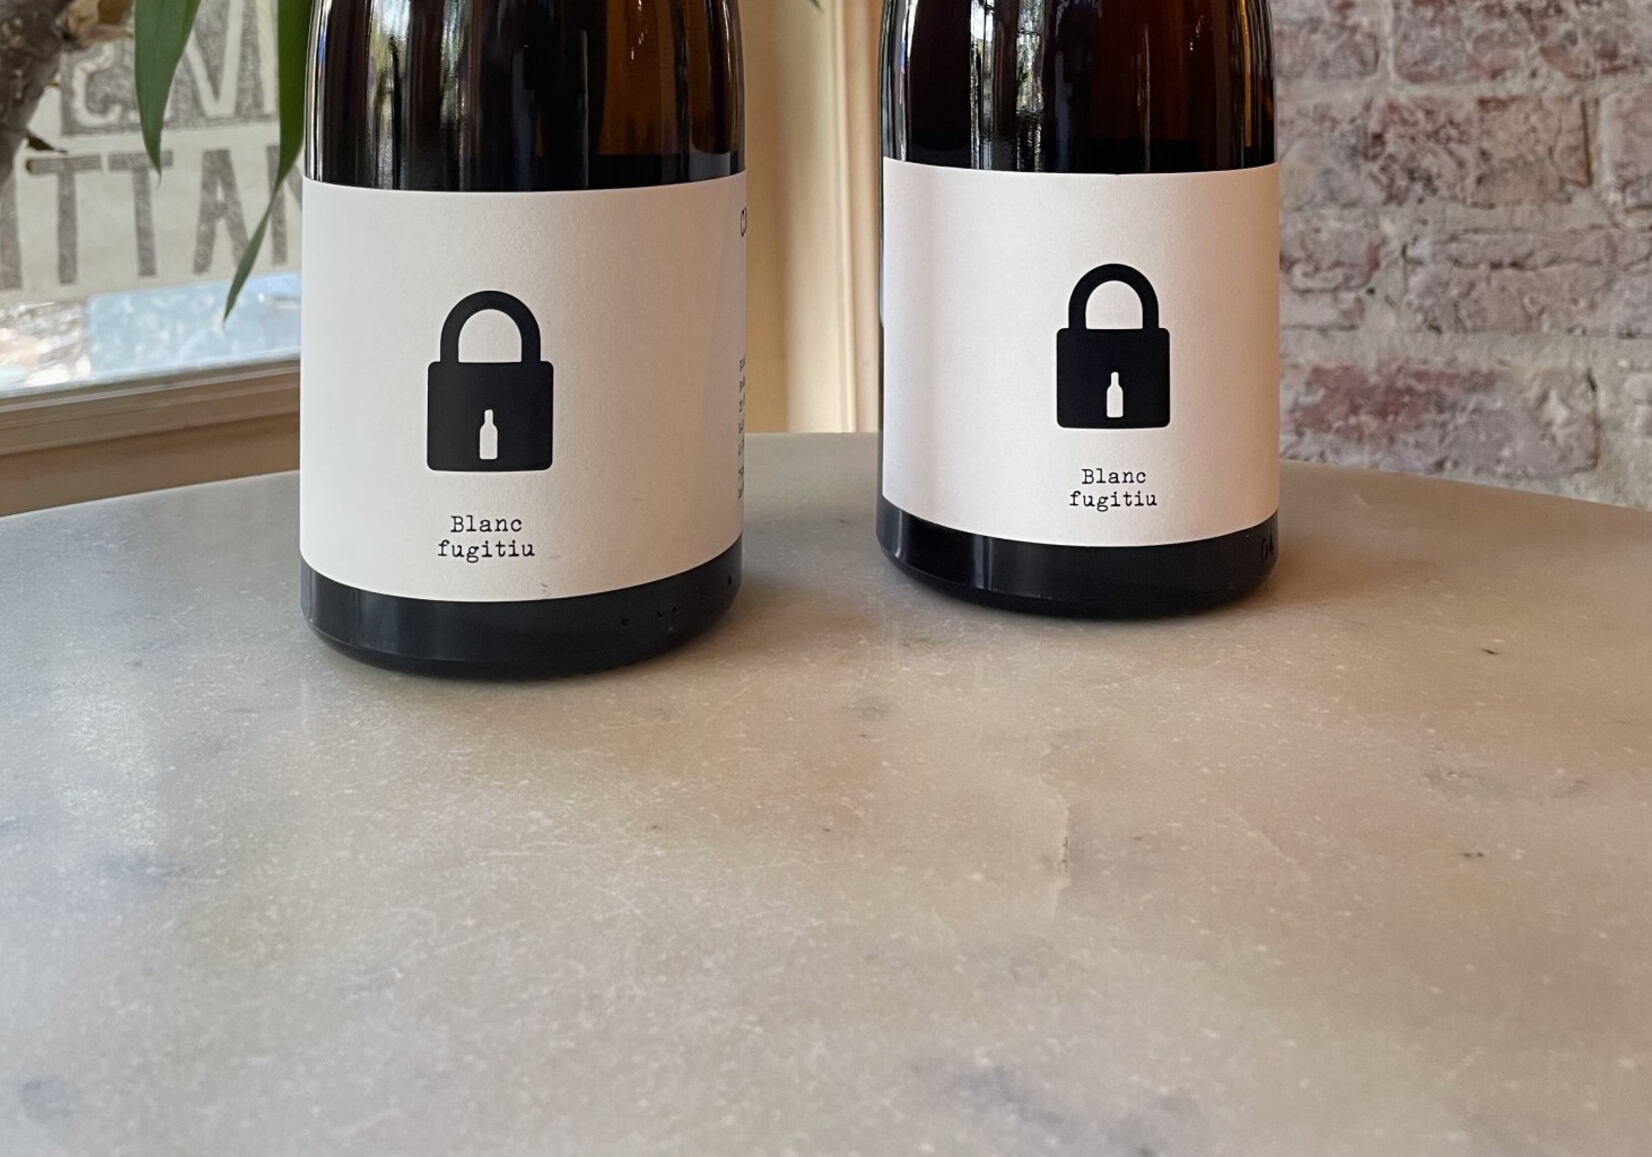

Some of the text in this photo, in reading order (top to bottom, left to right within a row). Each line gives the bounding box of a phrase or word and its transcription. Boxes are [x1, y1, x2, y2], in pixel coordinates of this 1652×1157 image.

[1081, 468, 1147, 485] Blanc
[1069, 490, 1158, 513] fugitiu
[450, 514, 523, 533] Blanc
[437, 539, 536, 564] fugitiu
